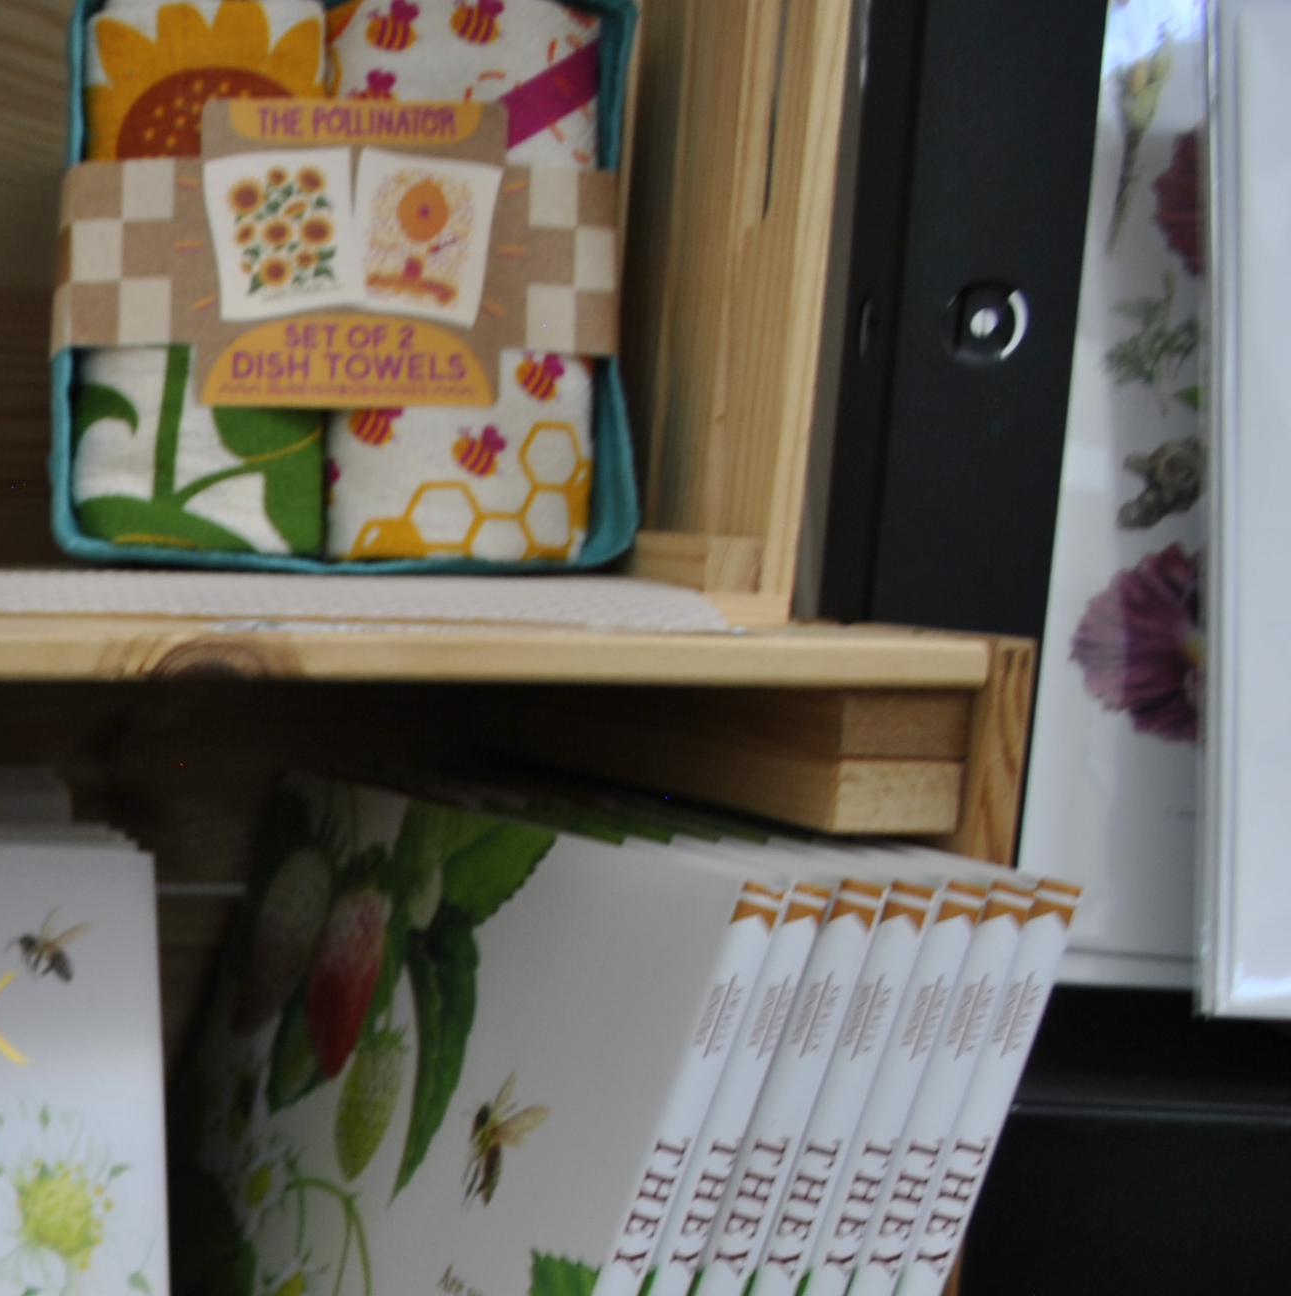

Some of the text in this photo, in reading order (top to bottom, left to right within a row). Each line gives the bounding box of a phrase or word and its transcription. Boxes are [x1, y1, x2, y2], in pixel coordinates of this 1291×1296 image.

[257, 106, 457, 138] THE POLLINATOR
[231, 351, 467, 381] DISH TOWELS
[284, 323, 416, 350] SET OF 2
[614, 1136, 691, 1277] THEY
[669, 1136, 739, 1277] THEY
[714, 1136, 790, 1277] THEY
[767, 1138, 842, 1280] THEY
[824, 1137, 895, 1278] THEY
[869, 1136, 943, 1278] THEY
[914, 1136, 992, 1278] THEY
